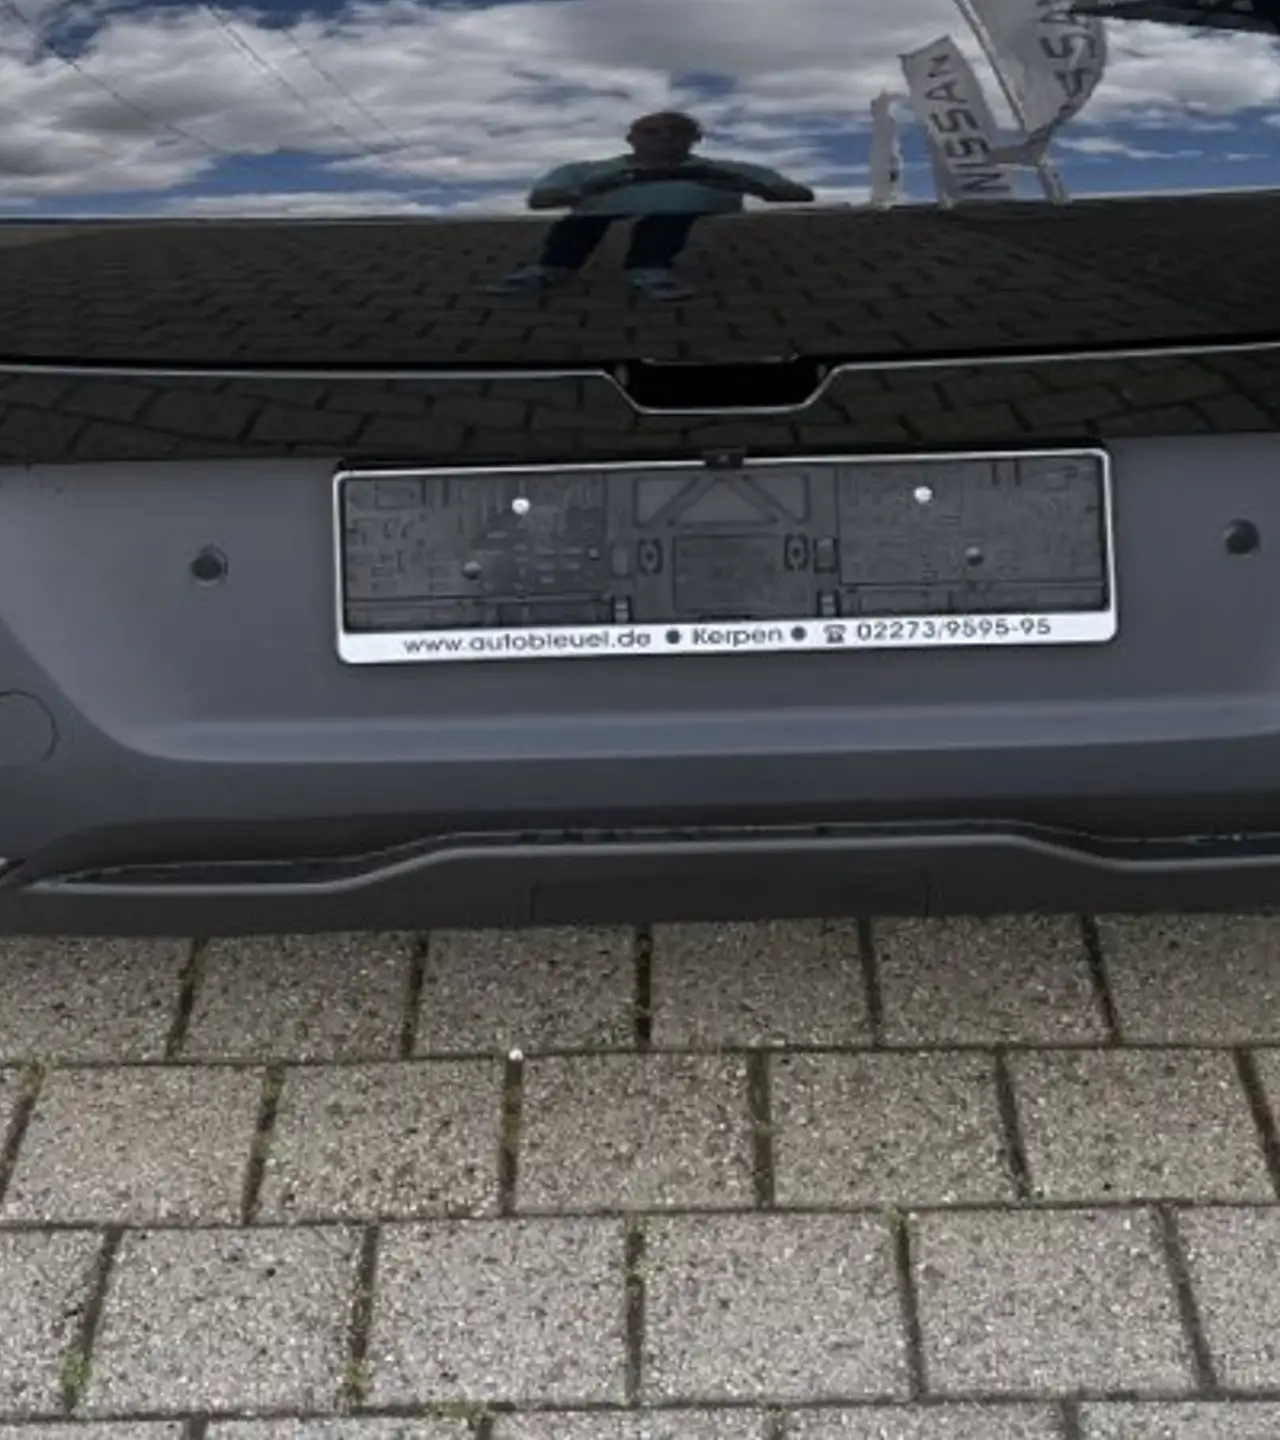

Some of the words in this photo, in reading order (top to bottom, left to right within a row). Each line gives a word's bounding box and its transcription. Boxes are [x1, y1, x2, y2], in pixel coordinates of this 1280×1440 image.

[924, 53, 1012, 194] NISSAN
[403, 629, 651, 654] www.autobleuel.de
[692, 626, 784, 648] Kerpen
[856, 616, 1052, 642] 02273/9595-95
